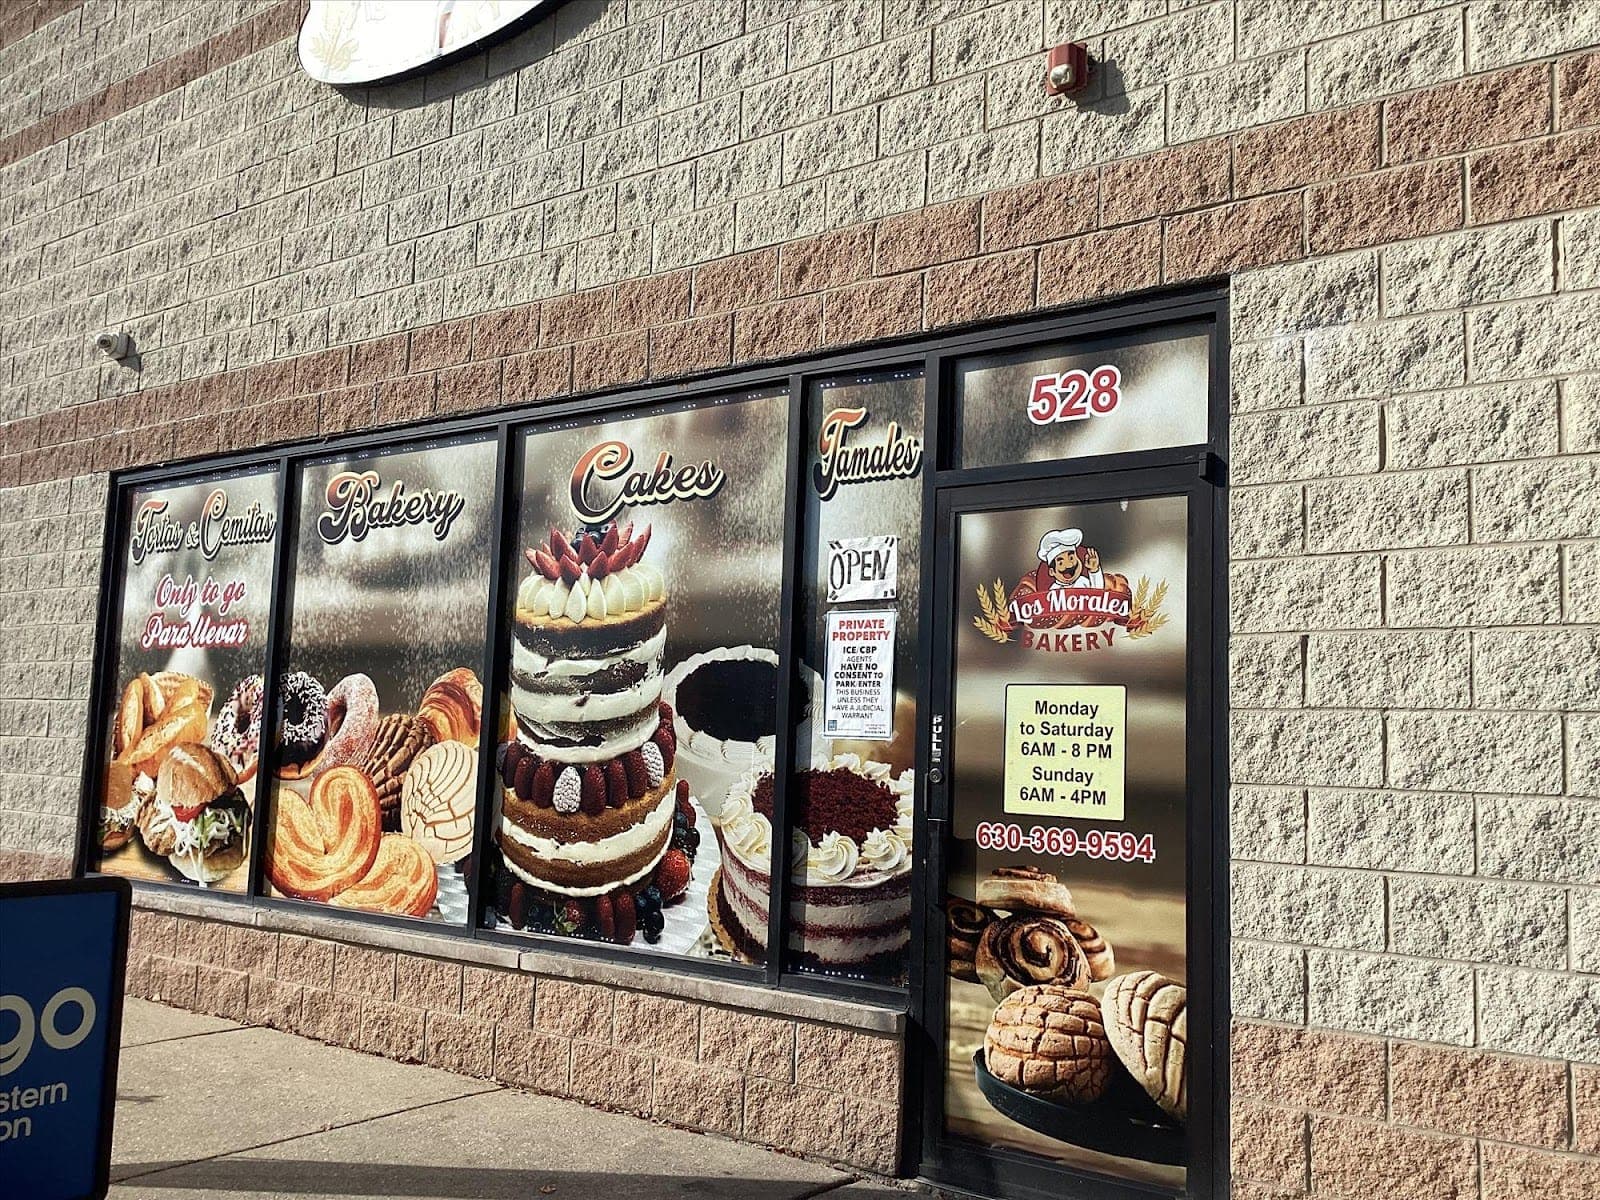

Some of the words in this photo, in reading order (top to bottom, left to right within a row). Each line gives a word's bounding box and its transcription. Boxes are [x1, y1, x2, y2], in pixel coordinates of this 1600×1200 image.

[1028, 365, 1120, 425] 528
[814, 407, 921, 501] Tamales
[570, 440, 727, 524] Cakes
[317, 470, 465, 543] Bakery
[132, 500, 184, 564] Tortas
[185, 526, 200, 549] &
[200, 488, 276, 560] Cemitas
[830, 549, 890, 590] OPEN
[156, 574, 198, 617] Only
[200, 576, 220, 606] to
[219, 580, 247, 615] go
[1009, 600, 1044, 623] Los
[1046, 590, 1130, 616] Morales
[142, 613, 192, 648] Para
[190, 615, 248, 646] llevar
[832, 631, 890, 641] PROPERTY
[839, 619, 885, 629] PRIVATE
[1020, 627, 1116, 652] BAKERY
[834, 671, 872, 679] CONSENT
[840, 663, 864, 671] HAVE
[1035, 701, 1099, 719] Monday
[1020, 722, 1035, 735] to
[1040, 721, 1114, 741] Saturday
[1021, 742, 1055, 757] 6AM
[1071, 744, 1081, 757] 8
[1086, 744, 1112, 759] PM
[1032, 766, 1094, 786] Sunday
[1020, 787, 1054, 802] 6AM
[1070, 789, 1106, 806] 4PM
[977, 822, 1156, 863] 630-369-9594
